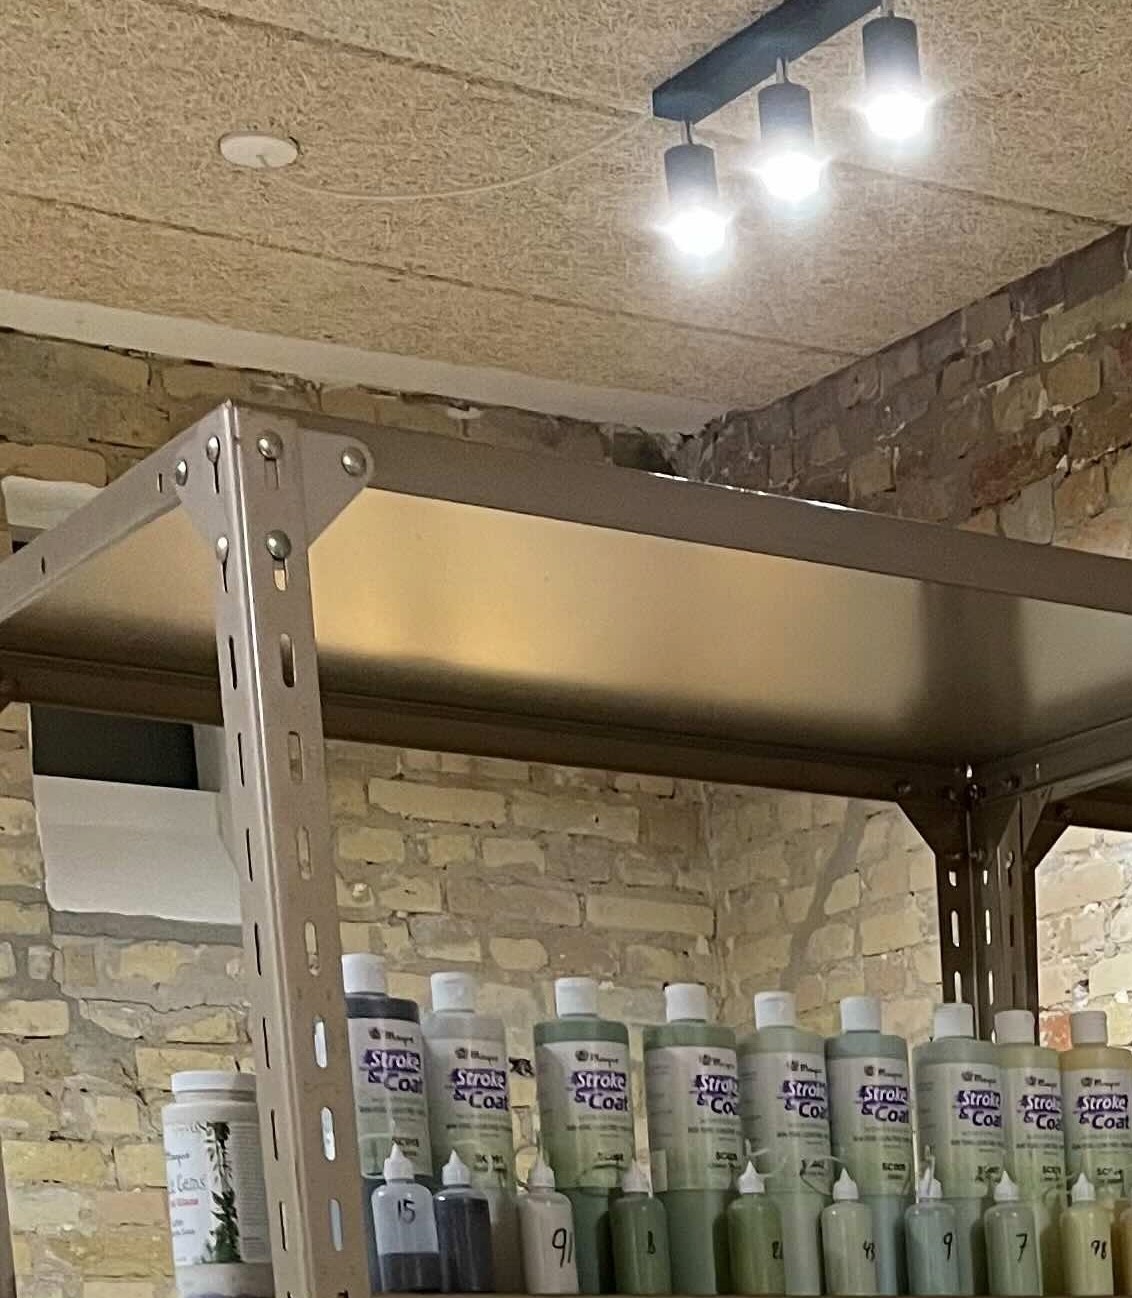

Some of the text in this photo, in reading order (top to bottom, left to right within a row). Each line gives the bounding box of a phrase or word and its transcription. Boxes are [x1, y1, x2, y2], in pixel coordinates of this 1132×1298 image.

[370, 1051, 421, 1069] Stroke
[384, 1073, 423, 1094] Coat
[456, 1070, 505, 1089] Stroke
[576, 1072, 626, 1088] Stroke
[700, 1076, 738, 1092] Stro
[469, 1092, 509, 1111] Coat
[589, 1094, 628, 1111] Coat
[1082, 1095, 1127, 1110] Stroke
[875, 1106, 909, 1123] Coat
[1092, 1114, 1129, 1129] Coat
[397, 1199, 416, 1223] 15
[551, 1228, 573, 1268] 91
[1015, 1233, 1028, 1262] 7
